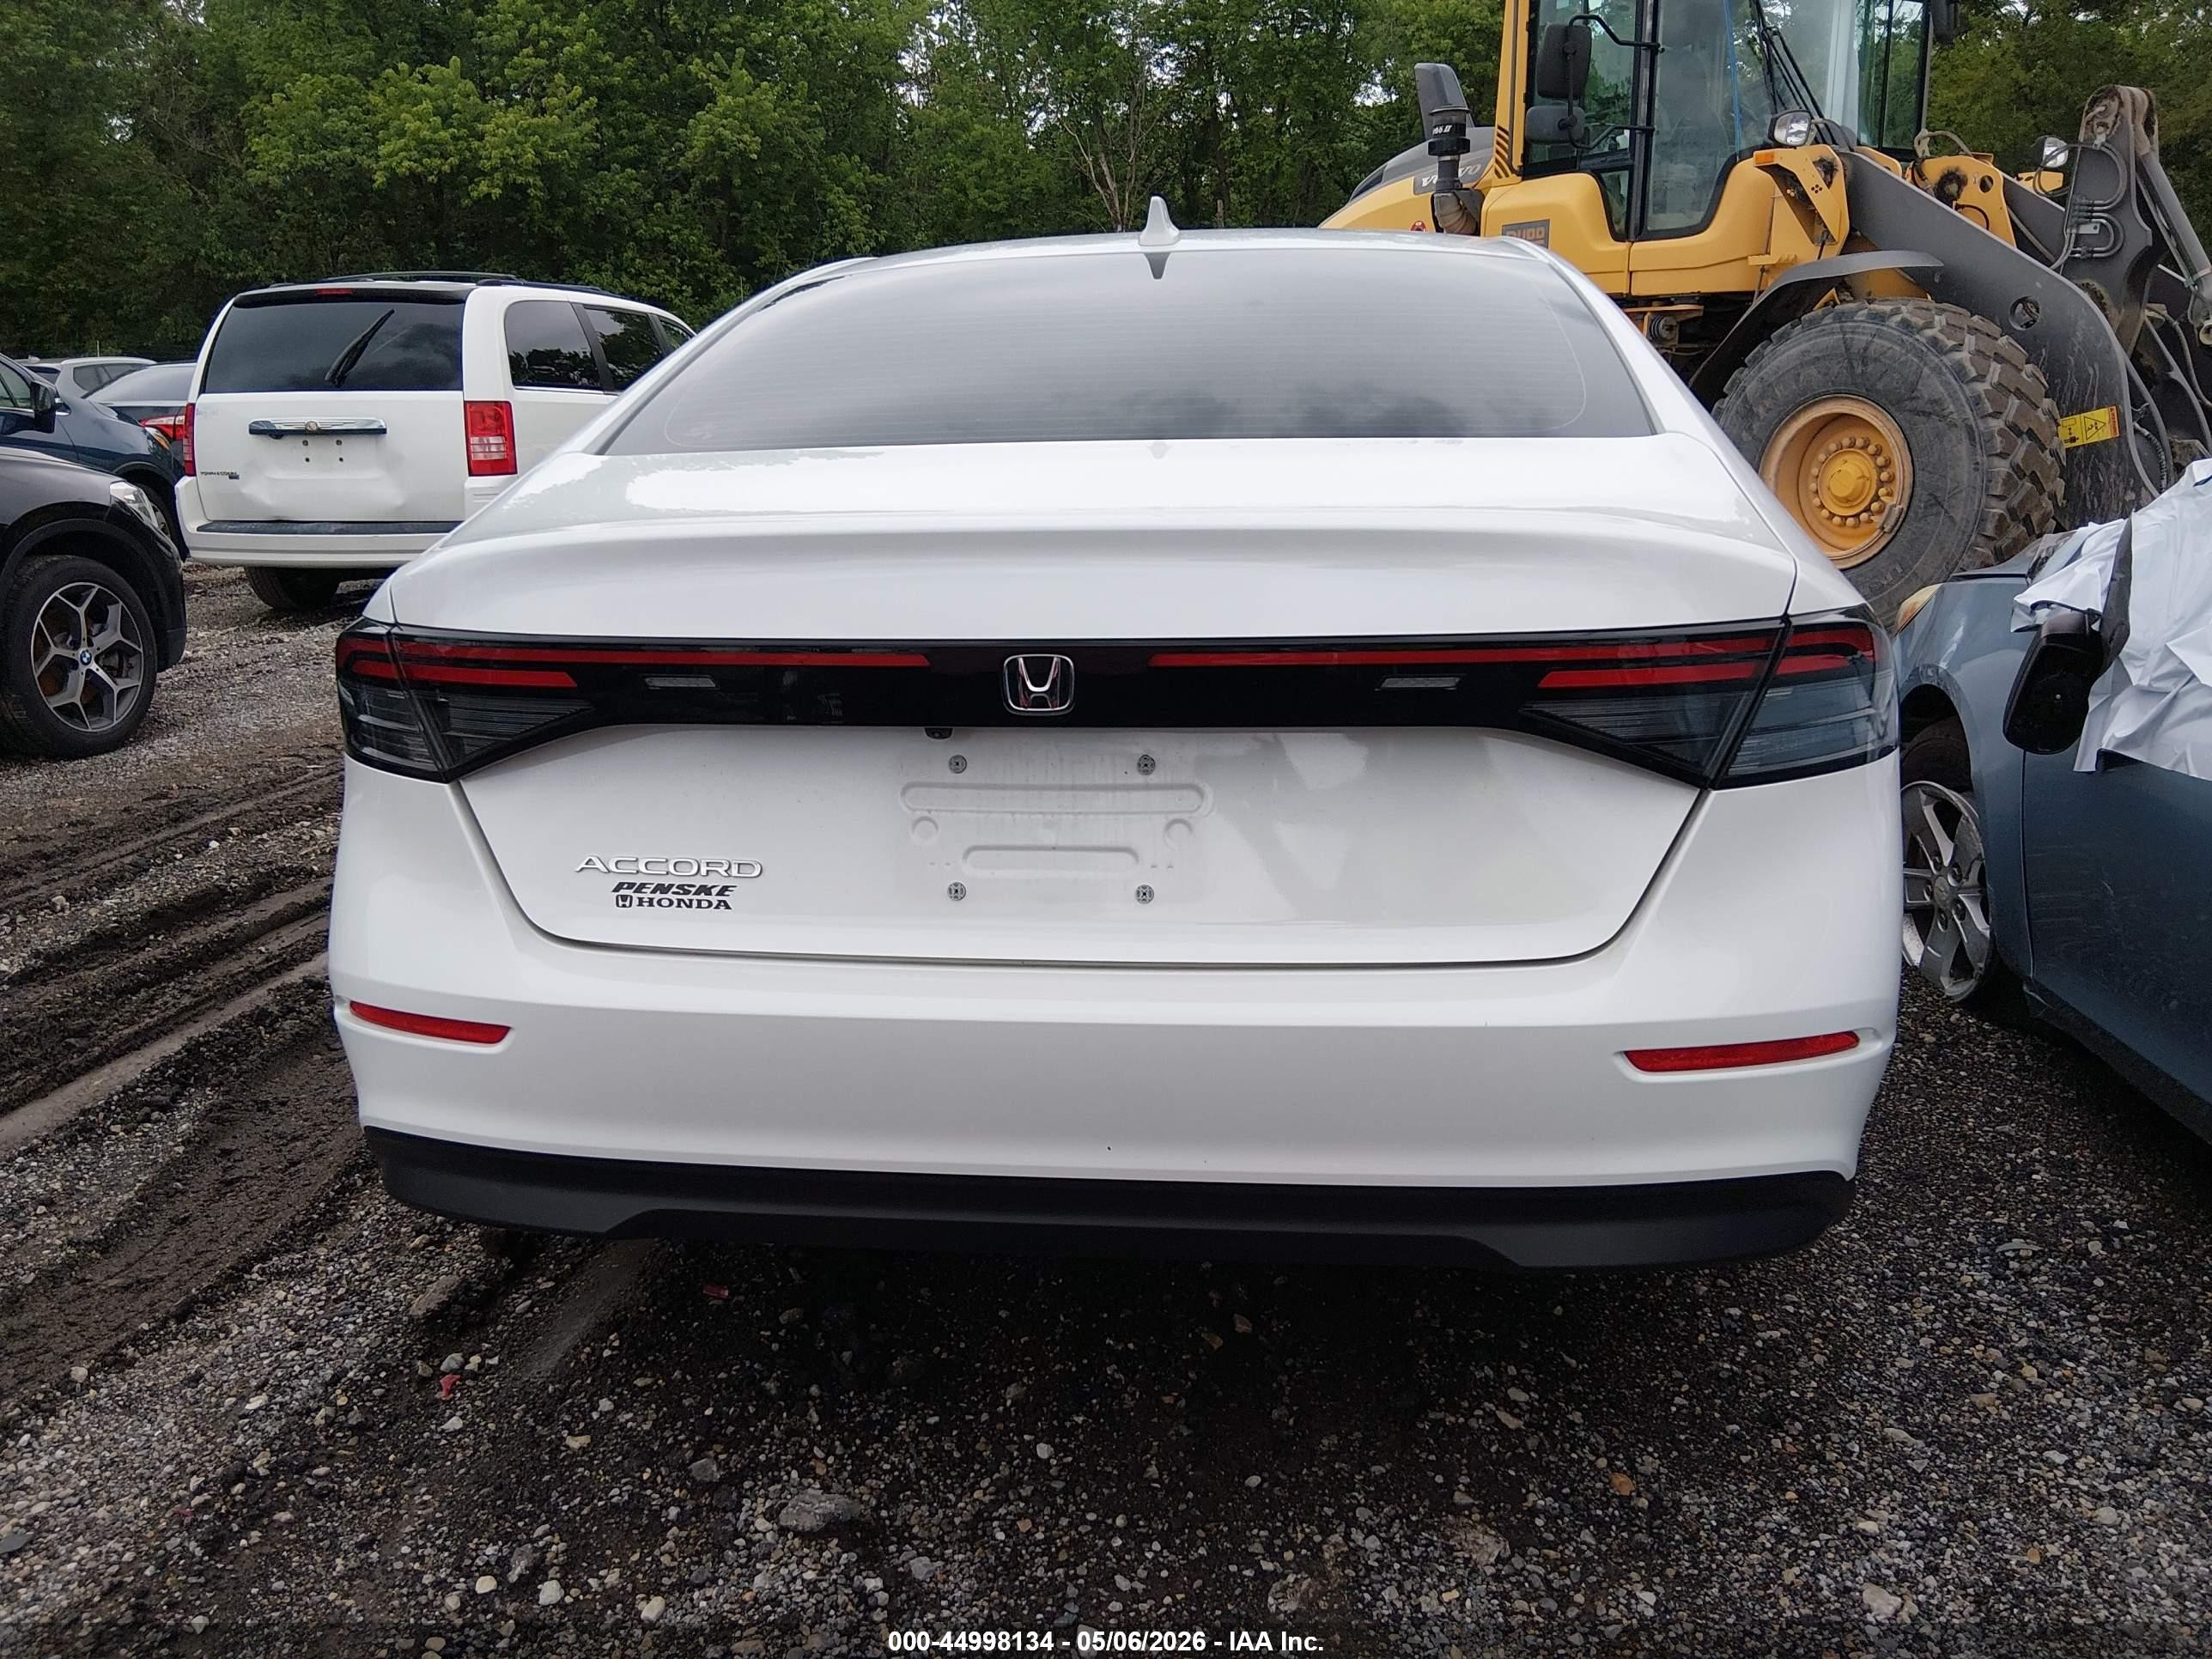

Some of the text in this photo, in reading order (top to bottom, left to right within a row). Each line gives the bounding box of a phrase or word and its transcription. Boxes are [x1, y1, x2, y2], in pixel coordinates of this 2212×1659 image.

[1422, 164, 1482, 187] VVO
[574, 855, 763, 878] ACCORD
[611, 881, 737, 896] PENSKE
[637, 896, 732, 910] HONDA
